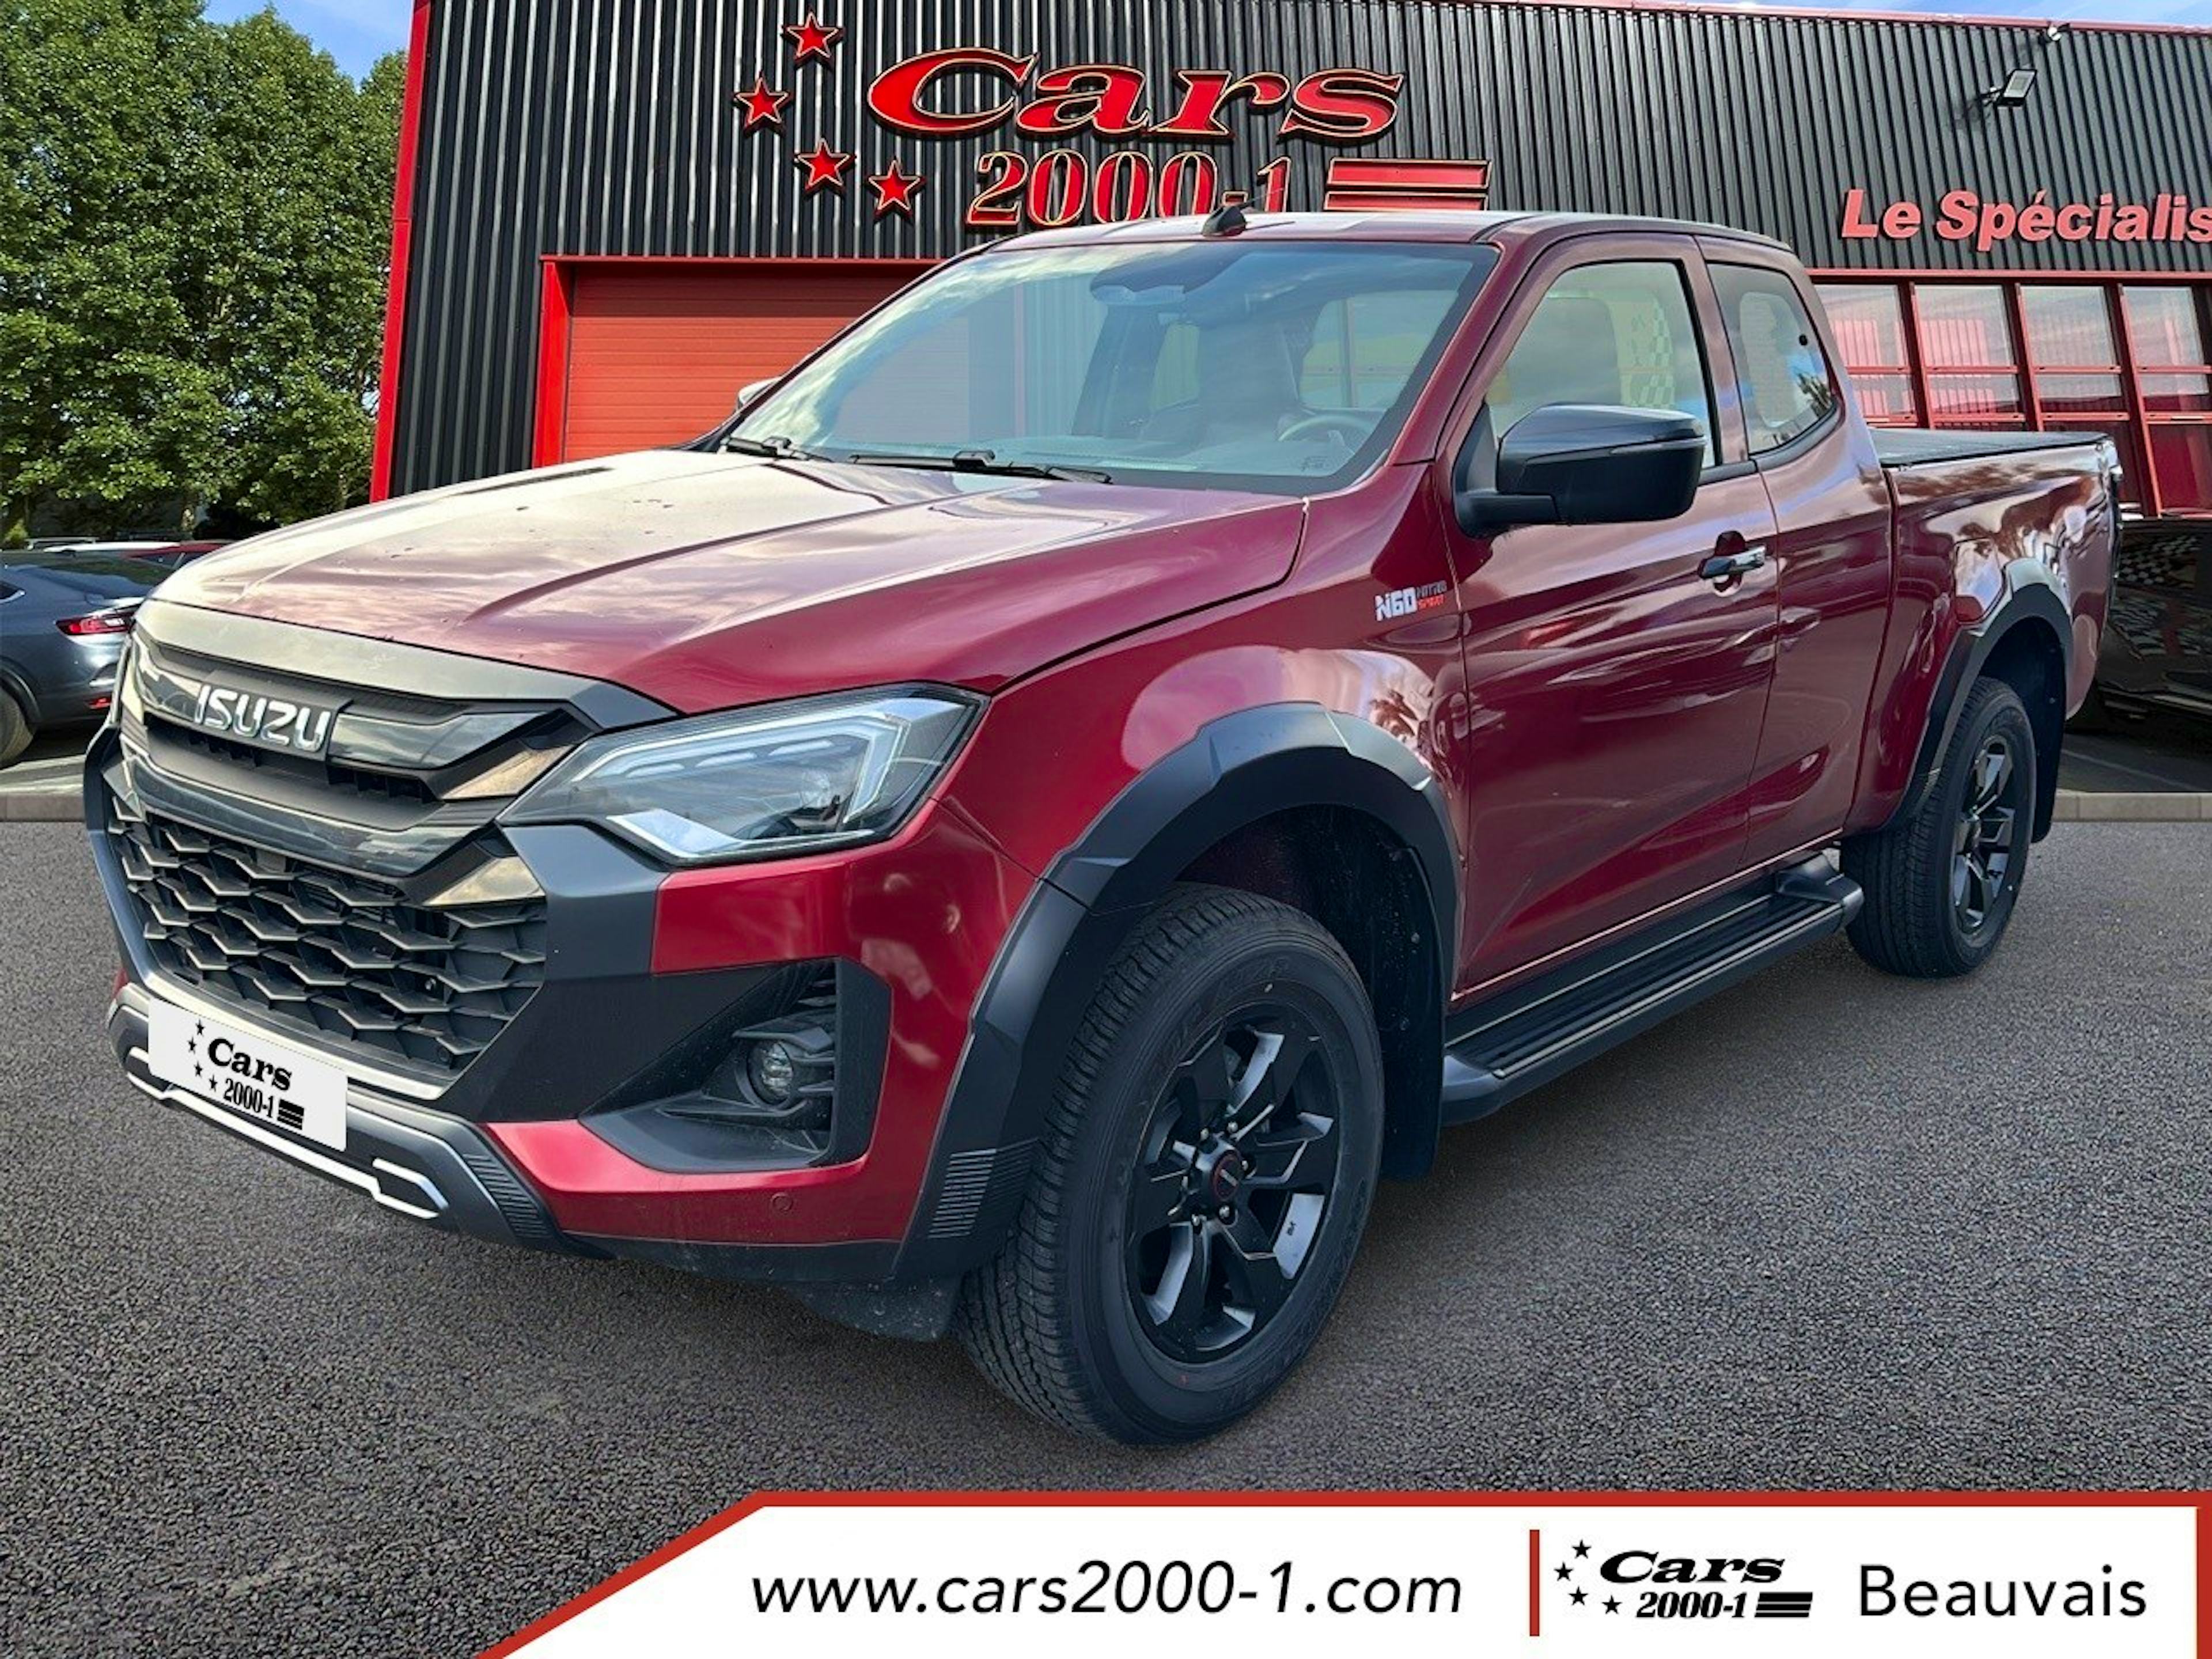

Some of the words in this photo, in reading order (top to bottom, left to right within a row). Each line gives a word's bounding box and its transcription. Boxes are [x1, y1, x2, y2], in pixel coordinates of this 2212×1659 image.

[866, 47, 1404, 138] Cars
[965, 149, 1293, 227] 2000-1
[1840, 188, 1921, 238] Le
[192, 684, 331, 751] ISUZU
[208, 1037, 293, 1091] Cars
[223, 1078, 274, 1118] 2000-1
